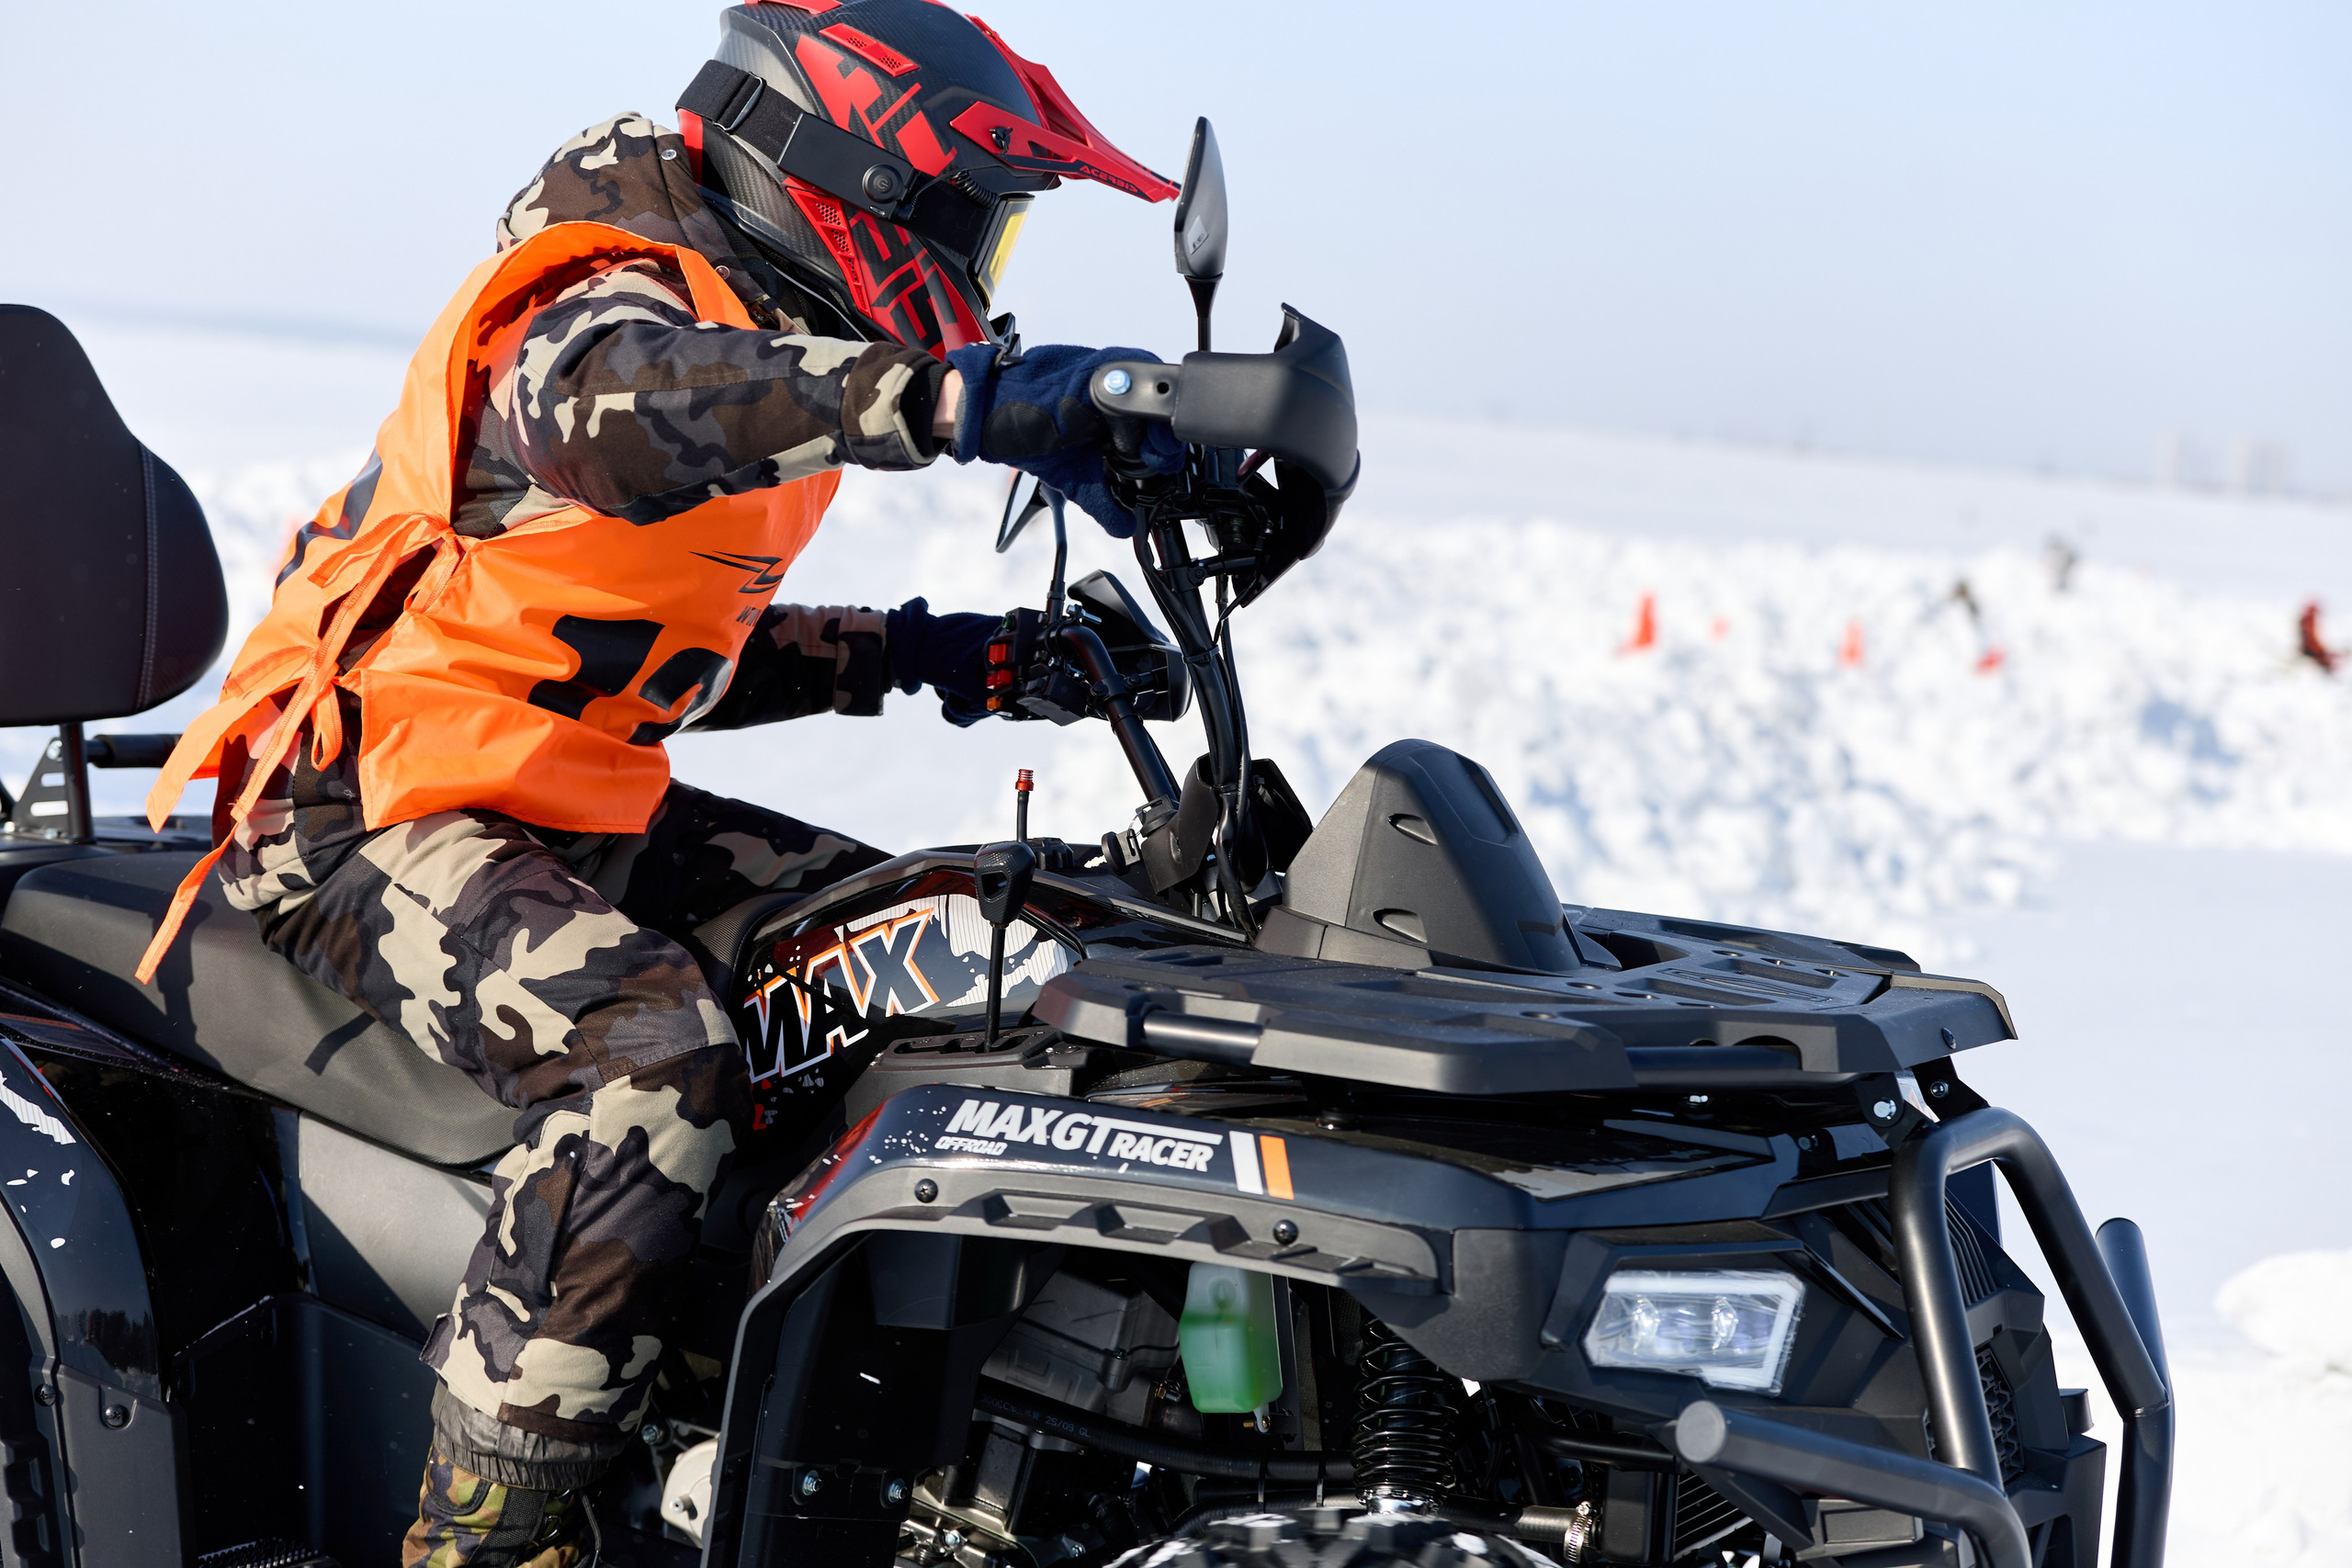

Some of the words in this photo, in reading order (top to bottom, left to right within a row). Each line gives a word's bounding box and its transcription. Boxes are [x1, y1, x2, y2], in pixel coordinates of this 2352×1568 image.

[1079, 164, 1138, 193] ACERBIS
[743, 908, 941, 1085] MAX
[933, 1134, 1009, 1156] OFFROAD
[1107, 1131, 1215, 1173] RACER
